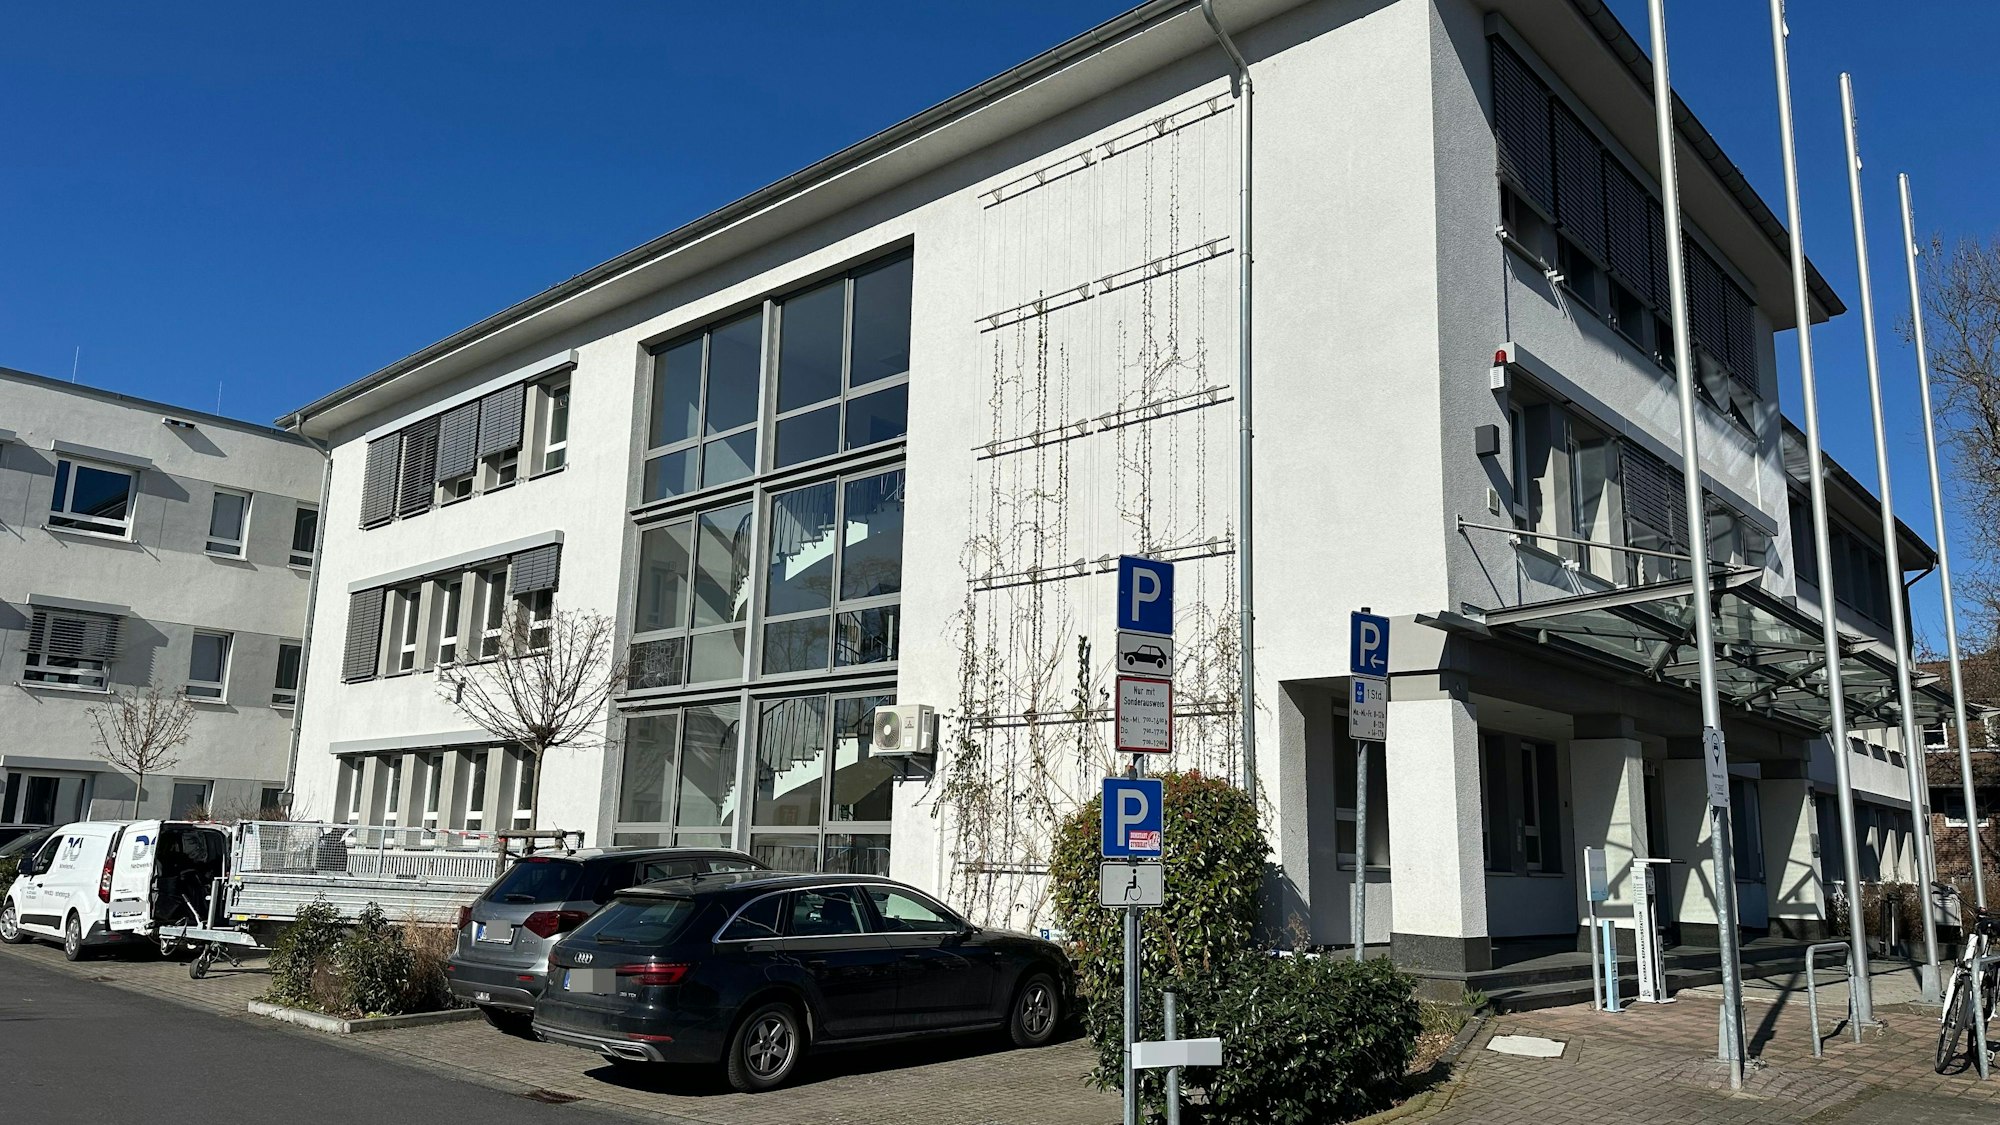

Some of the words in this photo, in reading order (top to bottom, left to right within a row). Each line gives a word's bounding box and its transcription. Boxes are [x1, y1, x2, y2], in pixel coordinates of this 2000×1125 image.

[1132, 566, 1161, 621] P
[1360, 621, 1380, 666] P
[1124, 696, 1165, 707] Sonderausweis
[1133, 686, 1144, 695] Nur
[1146, 687, 1155, 696] mit
[1117, 788, 1148, 846] P
